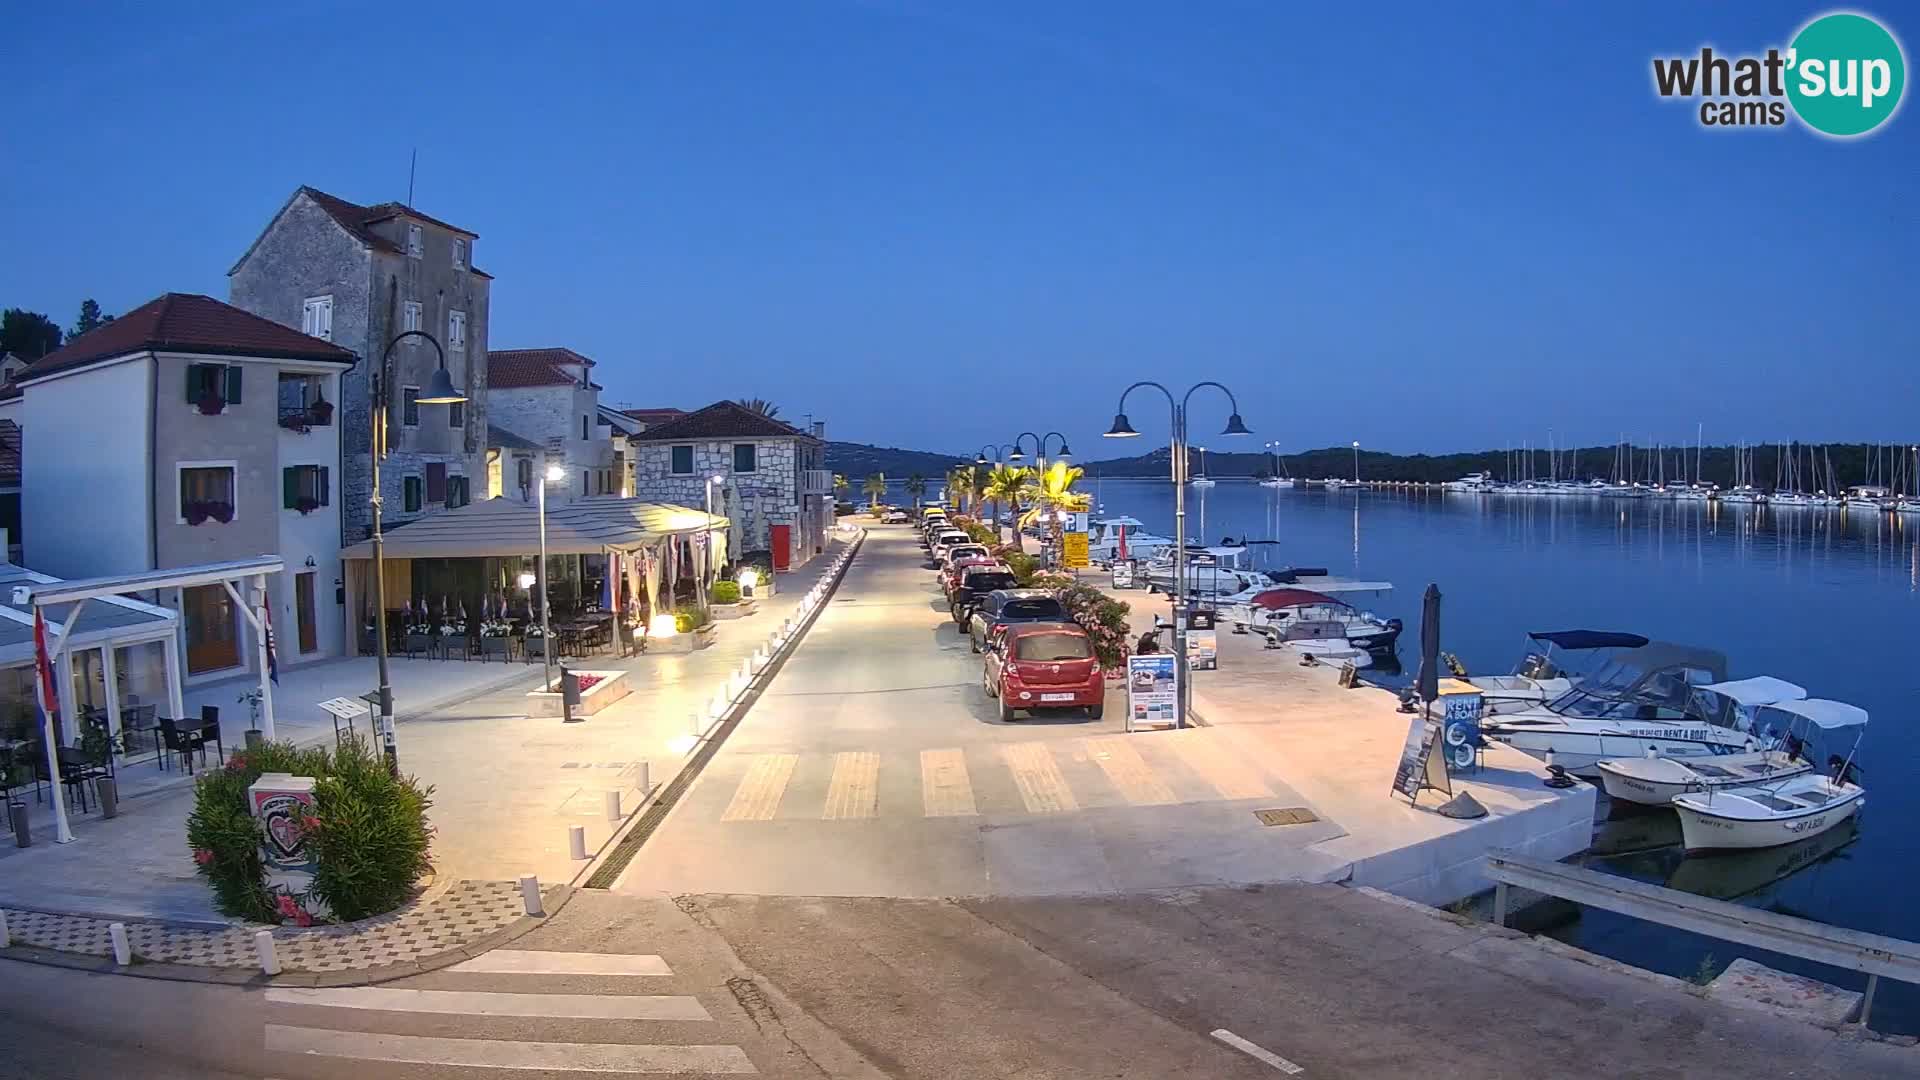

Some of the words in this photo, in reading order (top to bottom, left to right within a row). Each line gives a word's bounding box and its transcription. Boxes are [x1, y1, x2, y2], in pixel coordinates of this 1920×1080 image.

[1447, 699, 1478, 711] RENT
[1447, 711, 1453, 720] A
[1455, 710, 1478, 720] BOAT
[1664, 729, 1682, 738] RENT
[1683, 729, 1688, 738] A
[1690, 730, 1708, 740] BOAT
